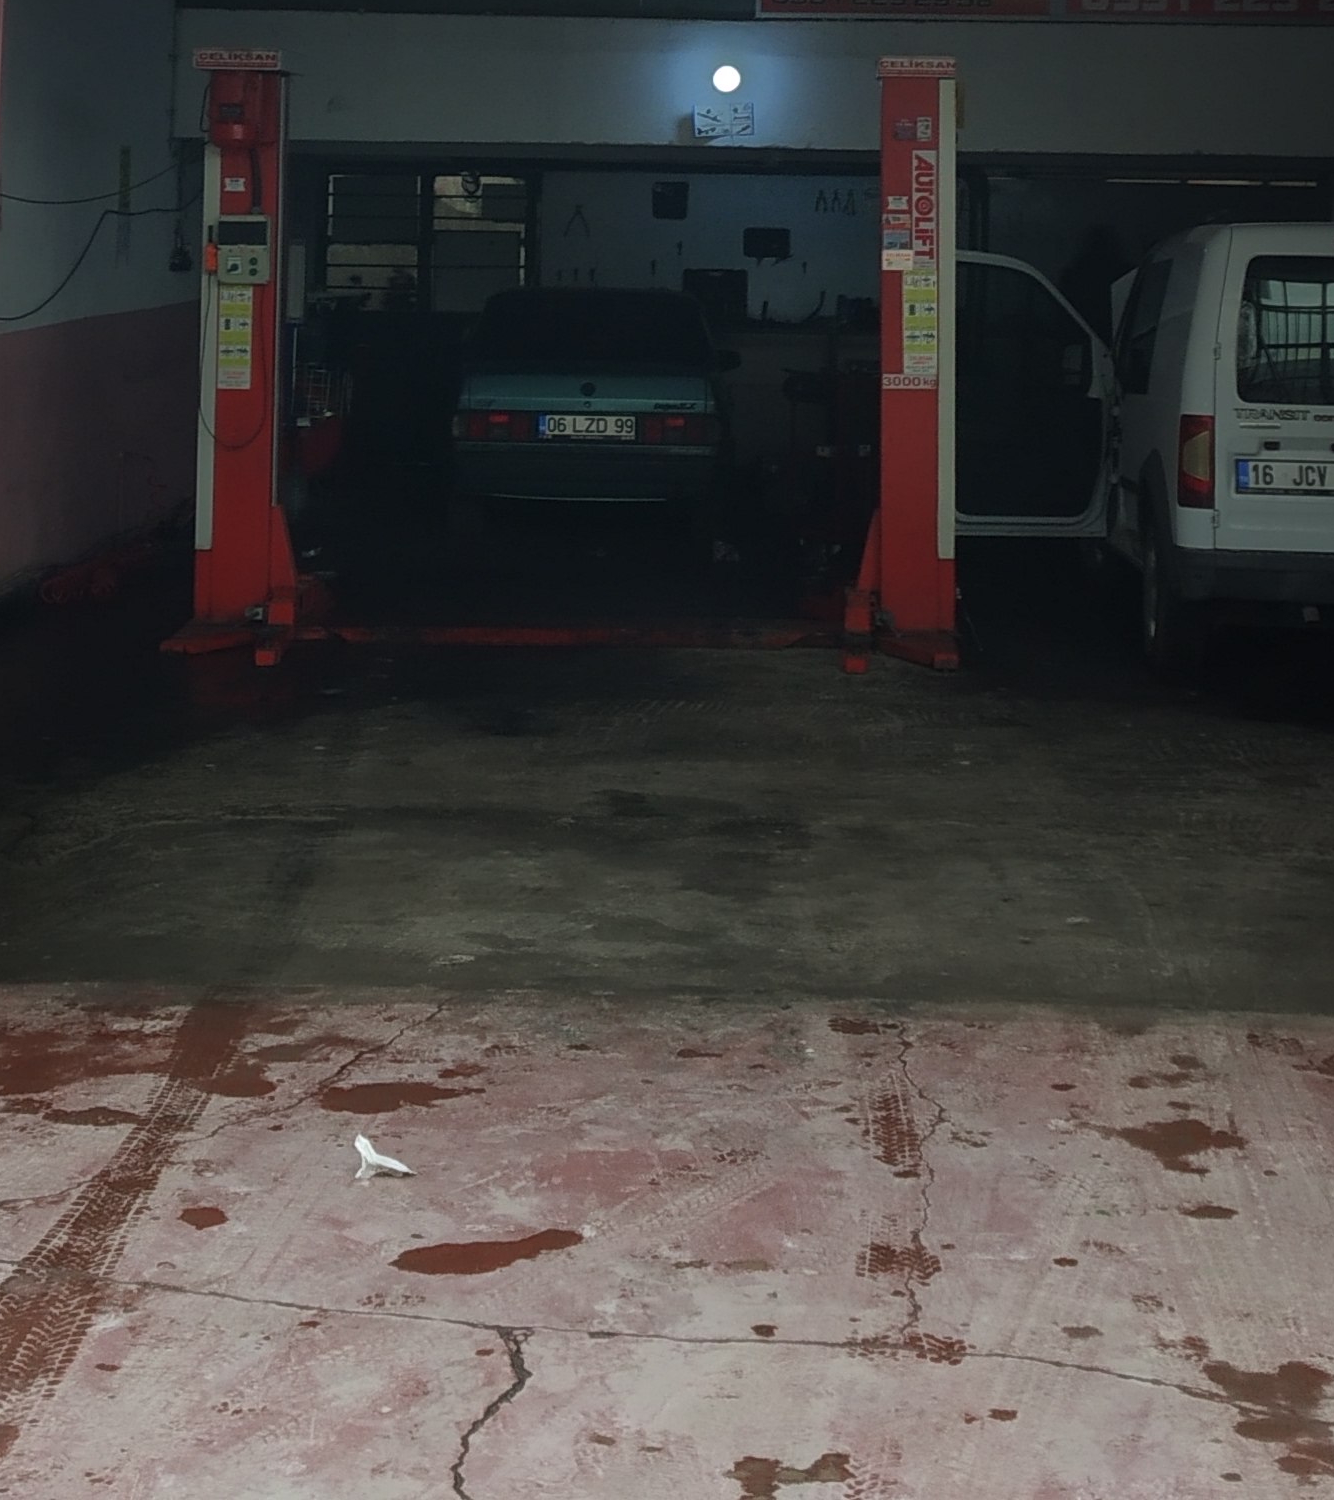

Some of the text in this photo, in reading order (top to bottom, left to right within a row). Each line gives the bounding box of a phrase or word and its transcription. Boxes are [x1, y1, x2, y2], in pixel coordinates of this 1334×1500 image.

[884, 377, 937, 388] 3000 kg
[1234, 408, 1310, 420] TRANSIT
[548, 418, 634, 434] 06 LZD 99
[1253, 464, 1274, 485] 16
[1293, 466, 1327, 487] JCV
